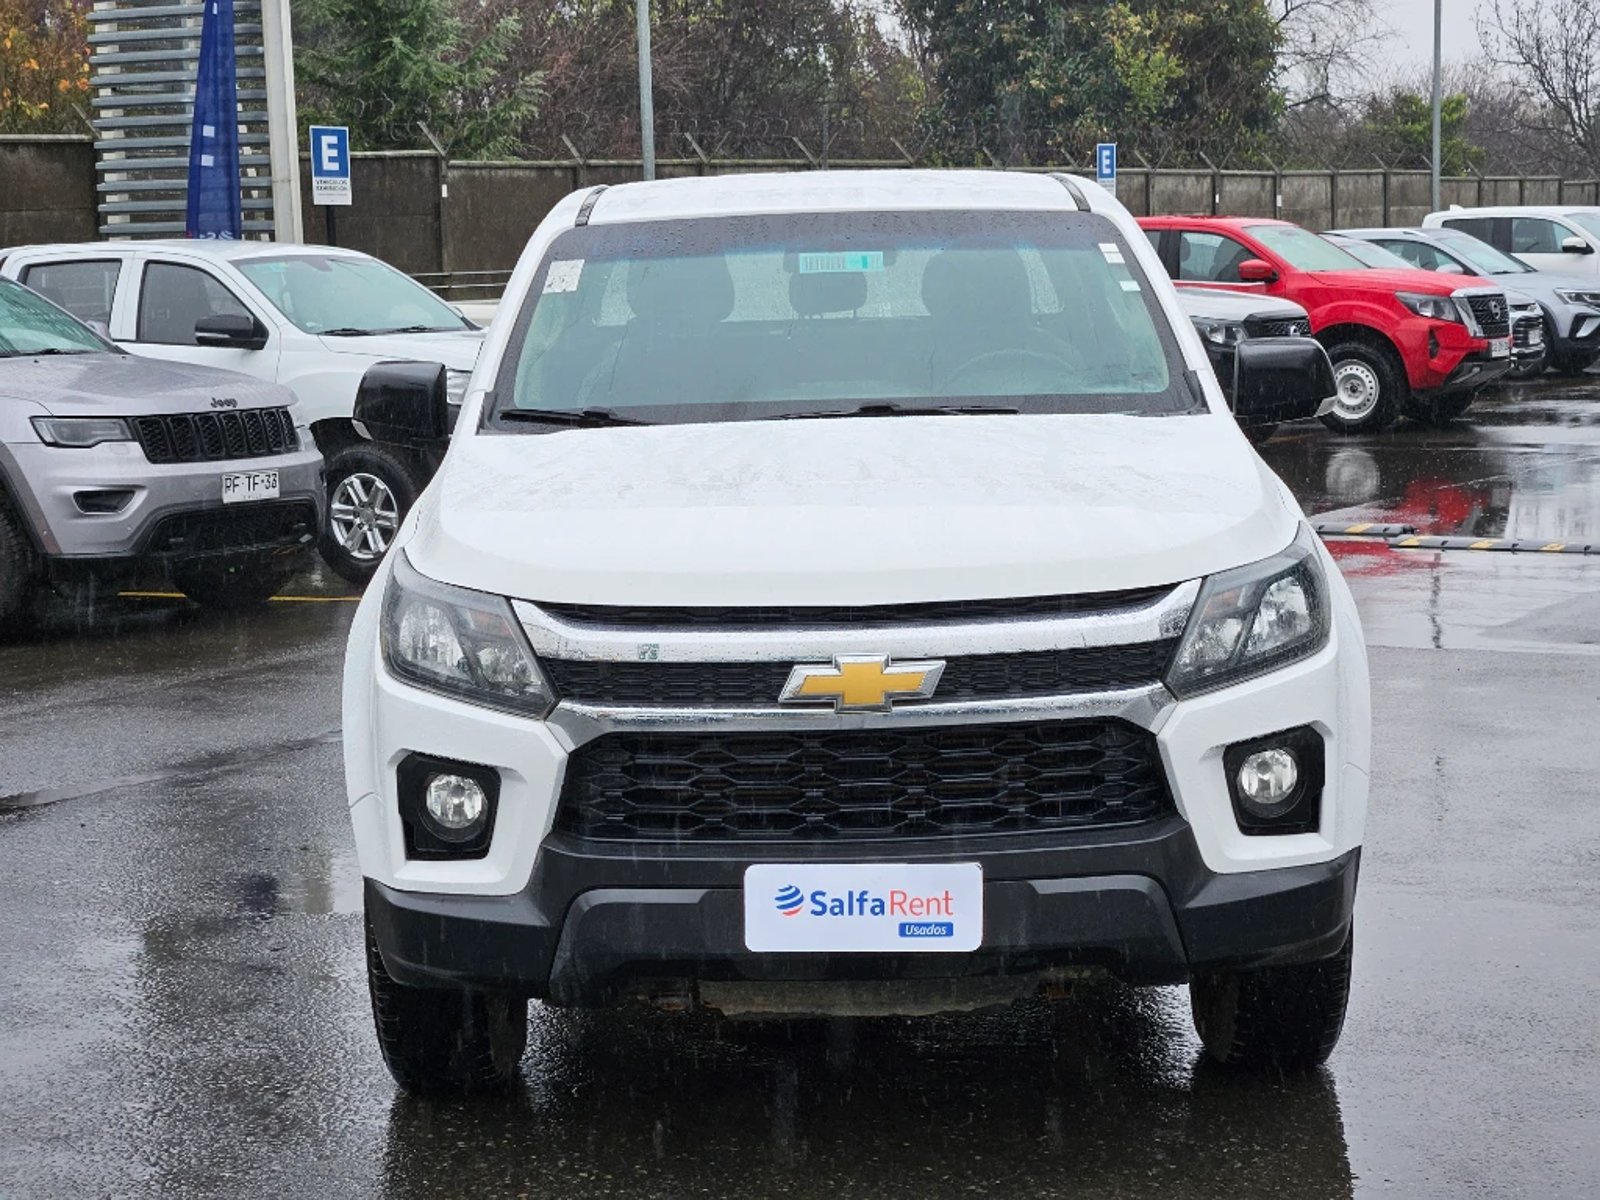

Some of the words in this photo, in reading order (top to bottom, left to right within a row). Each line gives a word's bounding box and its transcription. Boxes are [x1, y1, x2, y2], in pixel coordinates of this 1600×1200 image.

[321, 135, 340, 171] E
[1102, 149, 1111, 174] E
[210, 397, 238, 408] Jeep
[905, 924, 946, 935] Usados
